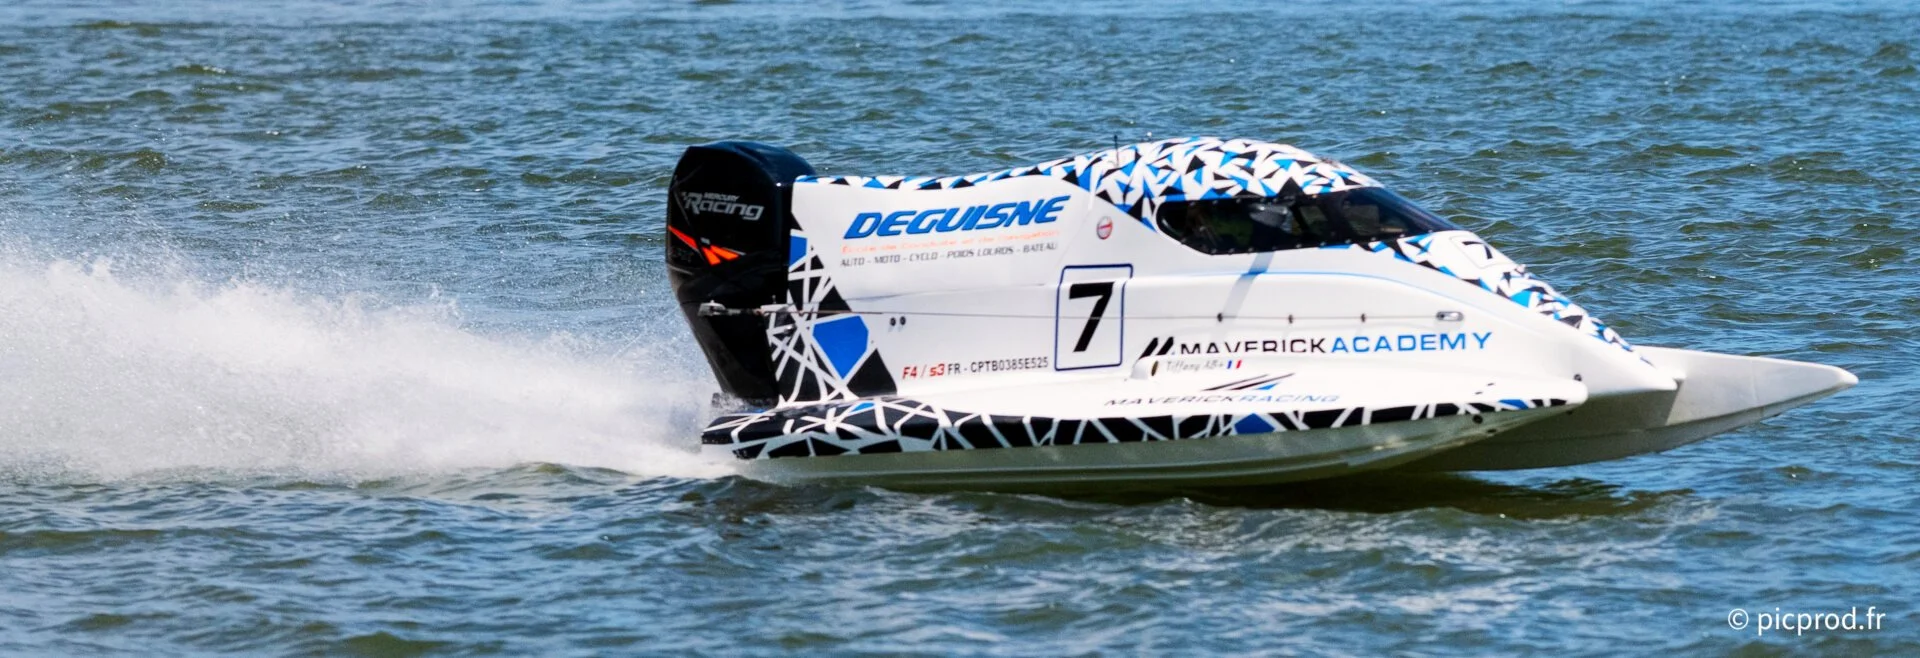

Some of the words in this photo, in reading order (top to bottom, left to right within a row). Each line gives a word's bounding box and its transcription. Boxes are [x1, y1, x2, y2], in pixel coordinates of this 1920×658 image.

[681, 191, 764, 221] Racing
[843, 195, 1071, 240] DEGUISNE
[874, 254, 901, 264] MOTO
[1462, 240, 1493, 260] 7
[1068, 281, 1115, 353] 7
[902, 365, 918, 379] F4
